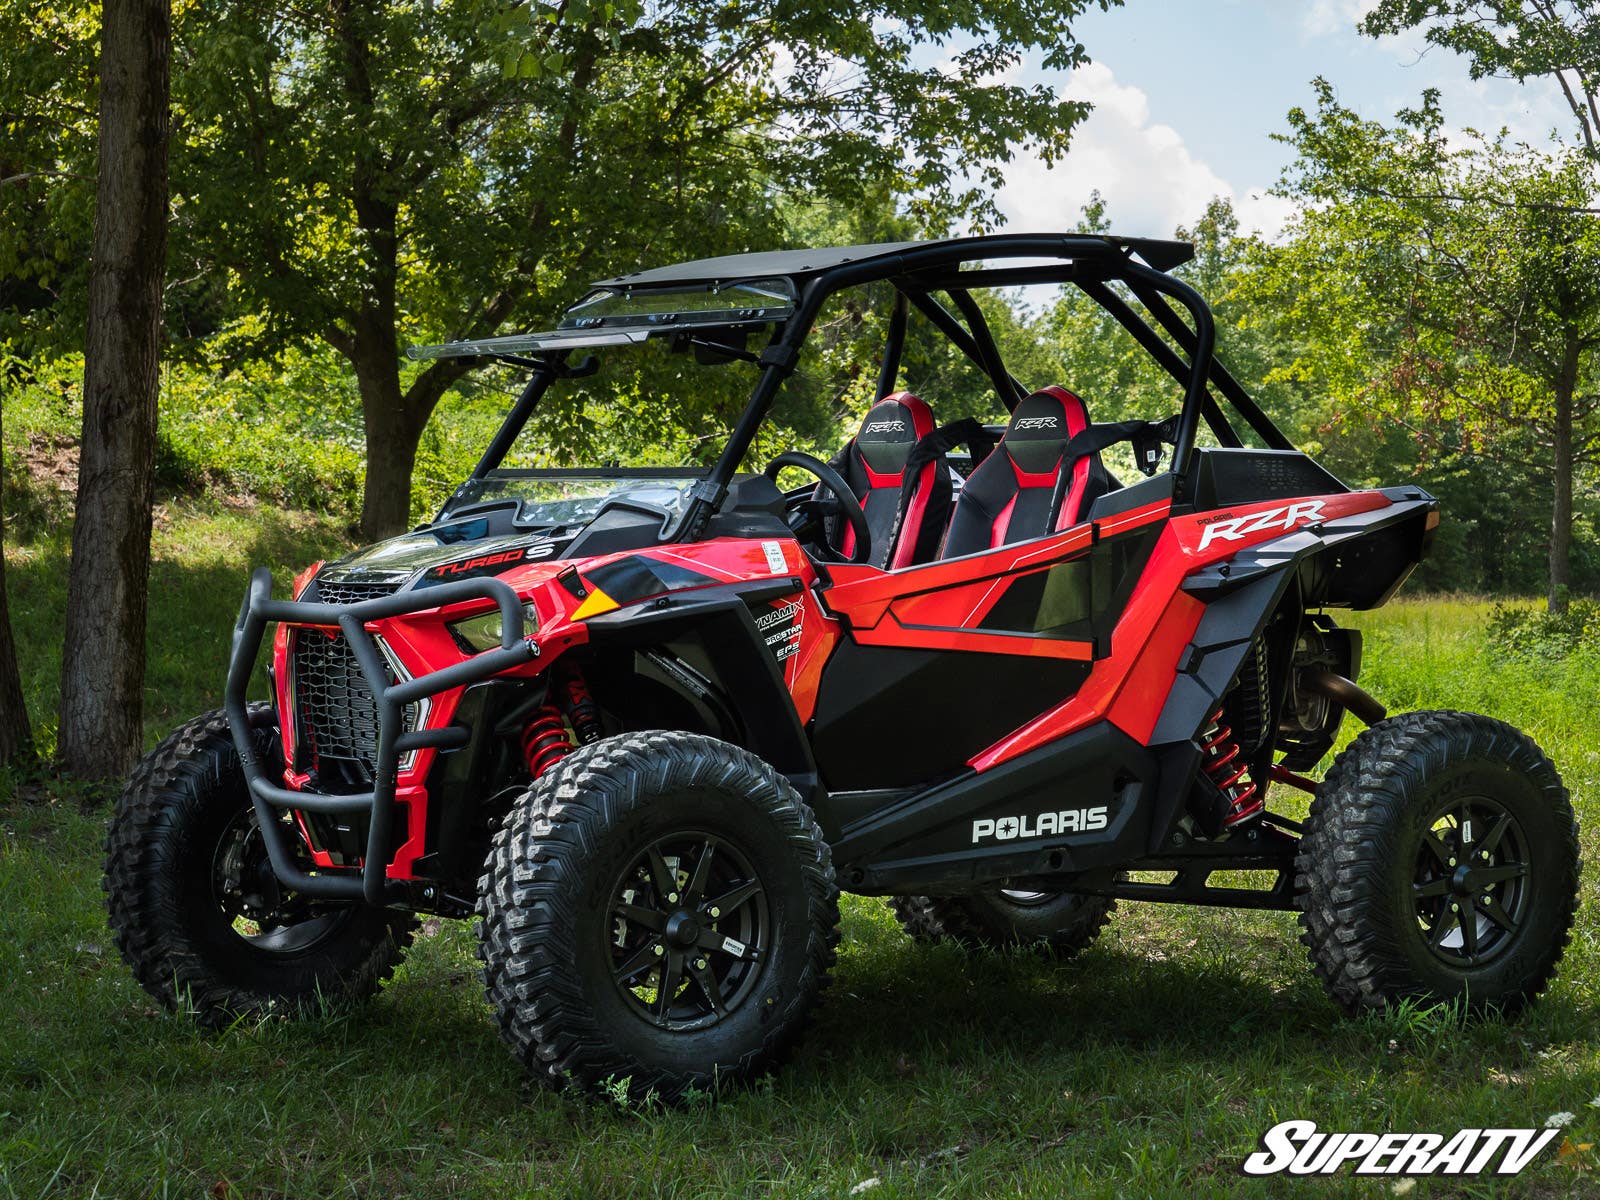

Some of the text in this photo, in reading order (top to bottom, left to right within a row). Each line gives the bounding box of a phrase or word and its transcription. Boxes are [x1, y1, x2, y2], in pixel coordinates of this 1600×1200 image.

[865, 420, 905, 434] RZR
[1014, 416, 1058, 431] RZR
[1196, 511, 1235, 526] POLARIS
[1197, 500, 1327, 553] RZR
[435, 542, 556, 576] TURBO S
[753, 595, 804, 629] YNAMIX
[764, 623, 802, 646] PROSTAR
[776, 641, 800, 657] EPS
[971, 805, 1108, 844] POLARIS
